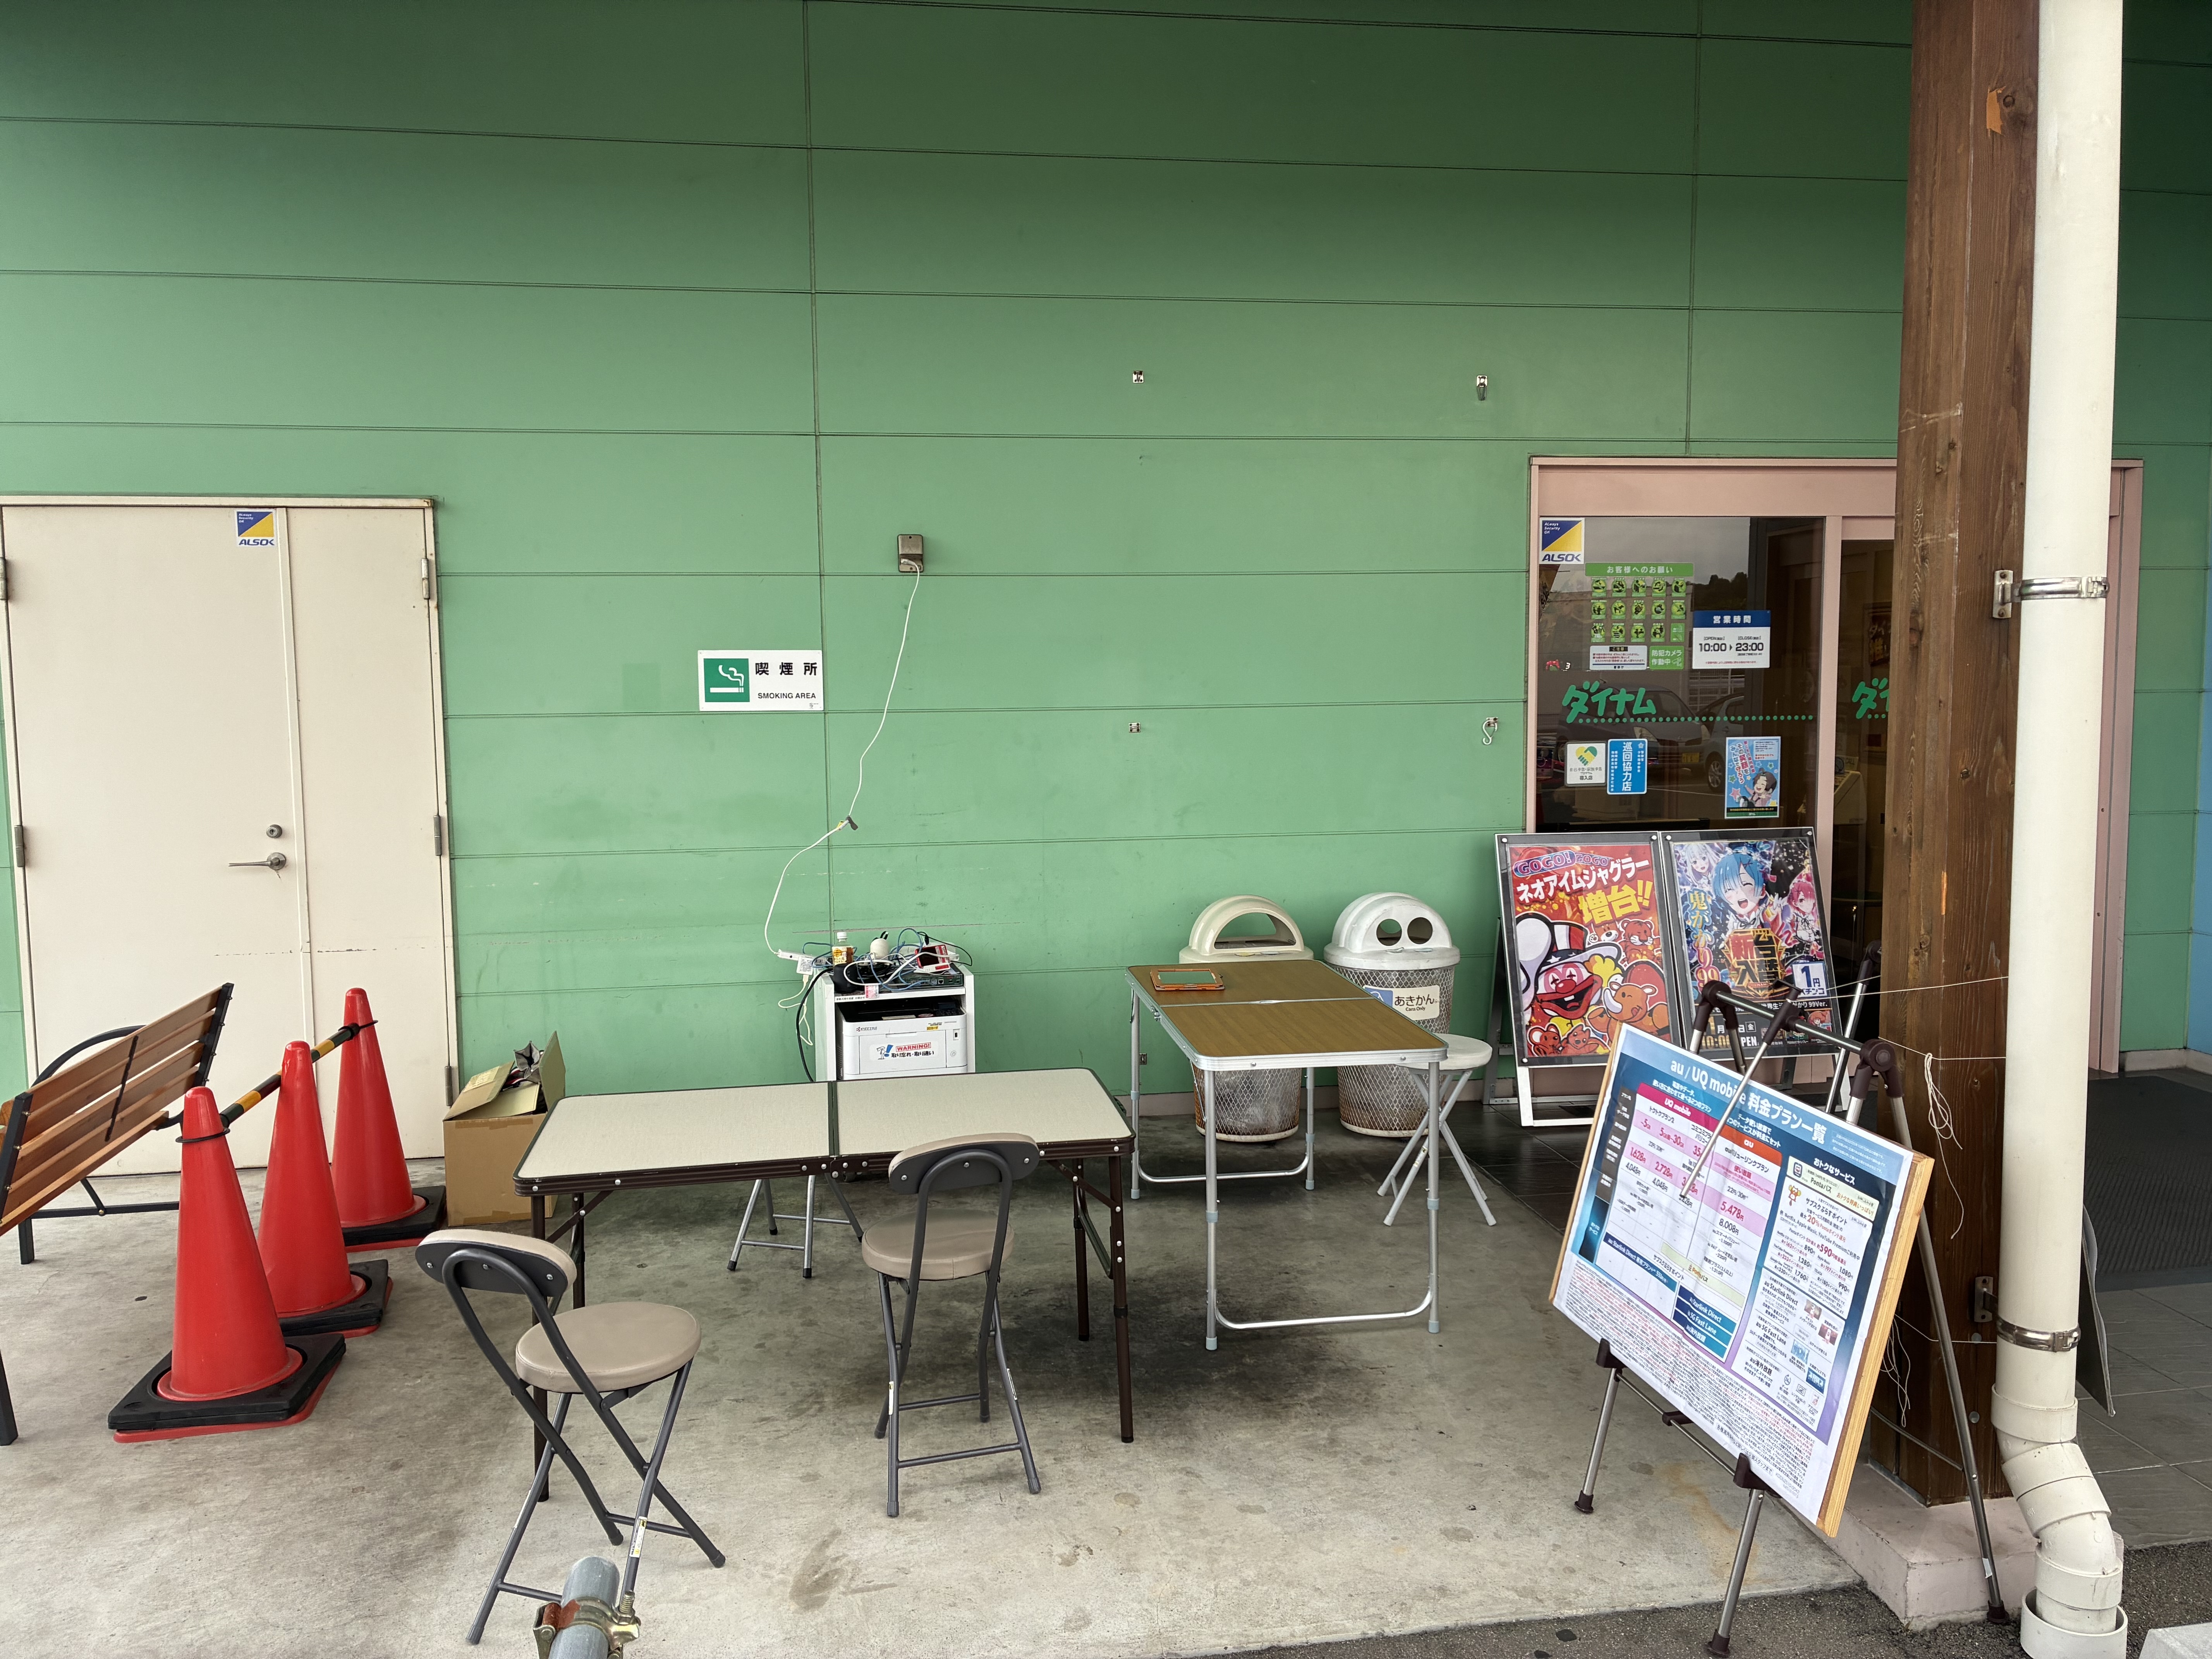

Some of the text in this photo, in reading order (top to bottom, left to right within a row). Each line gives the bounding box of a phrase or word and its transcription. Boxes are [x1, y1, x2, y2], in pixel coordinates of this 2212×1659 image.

[1713, 615, 1751, 623] 営業時間
[1699, 642, 1764, 652] 10:00 23:00
[755, 662, 817, 675] 喫煙所
[1562, 681, 1656, 723] ダイナム
[1622, 742, 1632, 791] 巡回協力店
[1517, 853, 1609, 875] GOGO! GOGO
[1516, 857, 1650, 903] ネオアイムジャグラー
[1801, 966, 1820, 988] 1円
[1395, 994, 1434, 1006] あきかん
[897, 1043, 930, 1051] WARNING!
[1740, 1036, 1757, 1047] PEN
[1664, 1097, 1674, 1108] UQ
[1670, 1060, 1685, 1075] au
[1689, 1065, 1710, 1090] UQ
[1708, 1074, 1748, 1106] mobie
[1747, 1092, 1828, 1145] 料金プラン一覧
[1690, 1124, 1712, 1140] コミコミプラ
[1743, 1138, 1754, 1149] au
[1813, 1157, 1856, 1186] おトクなサービス
[1810, 1177, 1832, 1193] Pontaパス
[1720, 1199, 1745, 1223] 5,478円
[1719, 1217, 1739, 1236] 8,008円
[1769, 1283, 1786, 1298] Starlink
[1786, 1293, 1798, 1306] Direct
[1692, 1297, 1708, 1314] Starlink
[1707, 1308, 1722, 1324] Direct
[1695, 1315, 1705, 1328] Fast
[1704, 1322, 1717, 1336] Lane
[1767, 1328, 1776, 1339] Fast
[1776, 1334, 1786, 1346] Lane
[1749, 1355, 1772, 1376] au海外放題
